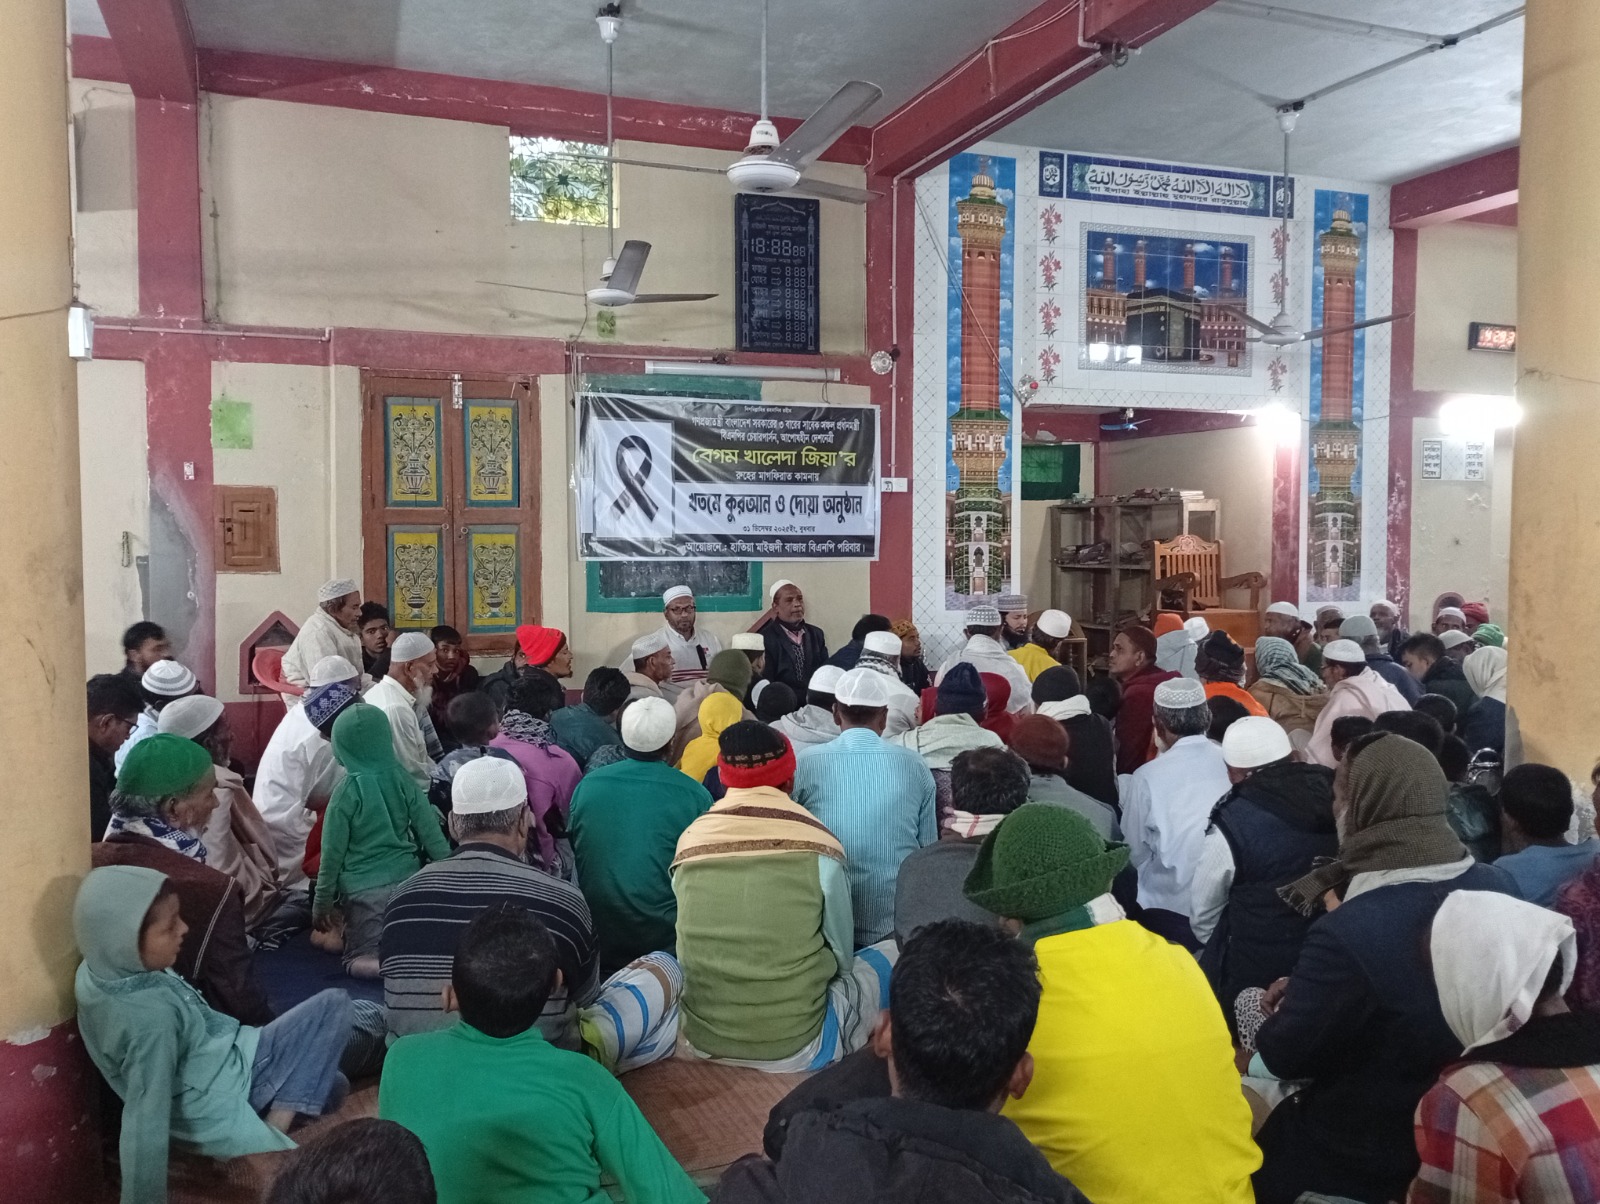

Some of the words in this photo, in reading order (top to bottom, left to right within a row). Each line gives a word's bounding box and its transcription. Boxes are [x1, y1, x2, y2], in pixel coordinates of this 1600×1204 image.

[725, 418, 751, 429] বাংলাদেশ
[752, 419, 778, 429] সরকারের
[778, 421, 784, 429] ৩
[785, 420, 801, 430] বারের
[802, 420, 819, 430] সাবেক
[720, 429, 745, 442] বিএনপির
[746, 431, 780, 445] চেয়ারপার্সন,
[811, 430, 834, 444] দেশনেত্রী
[692, 448, 739, 464] বেগম
[743, 450, 797, 466] খালেদা
[735, 470, 756, 481] রুহের
[758, 469, 793, 482] মাগফিরাত
[794, 472, 820, 482] কামনায়
[688, 493, 722, 515] খতমে
[725, 494, 771, 523] কুরআন
[775, 494, 785, 513] ও
[789, 495, 819, 517] দোয়া
[822, 490, 863, 524] অনুষ্ঠান
[752, 524, 773, 532] ডিসেম্বর
[799, 525, 816, 534] বুধবার
[730, 539, 754, 554] হাতিয়া
[755, 539, 783, 554] মাইজদী
[784, 542, 807, 553] বাজার
[808, 539, 835, 553] বিএনপি
